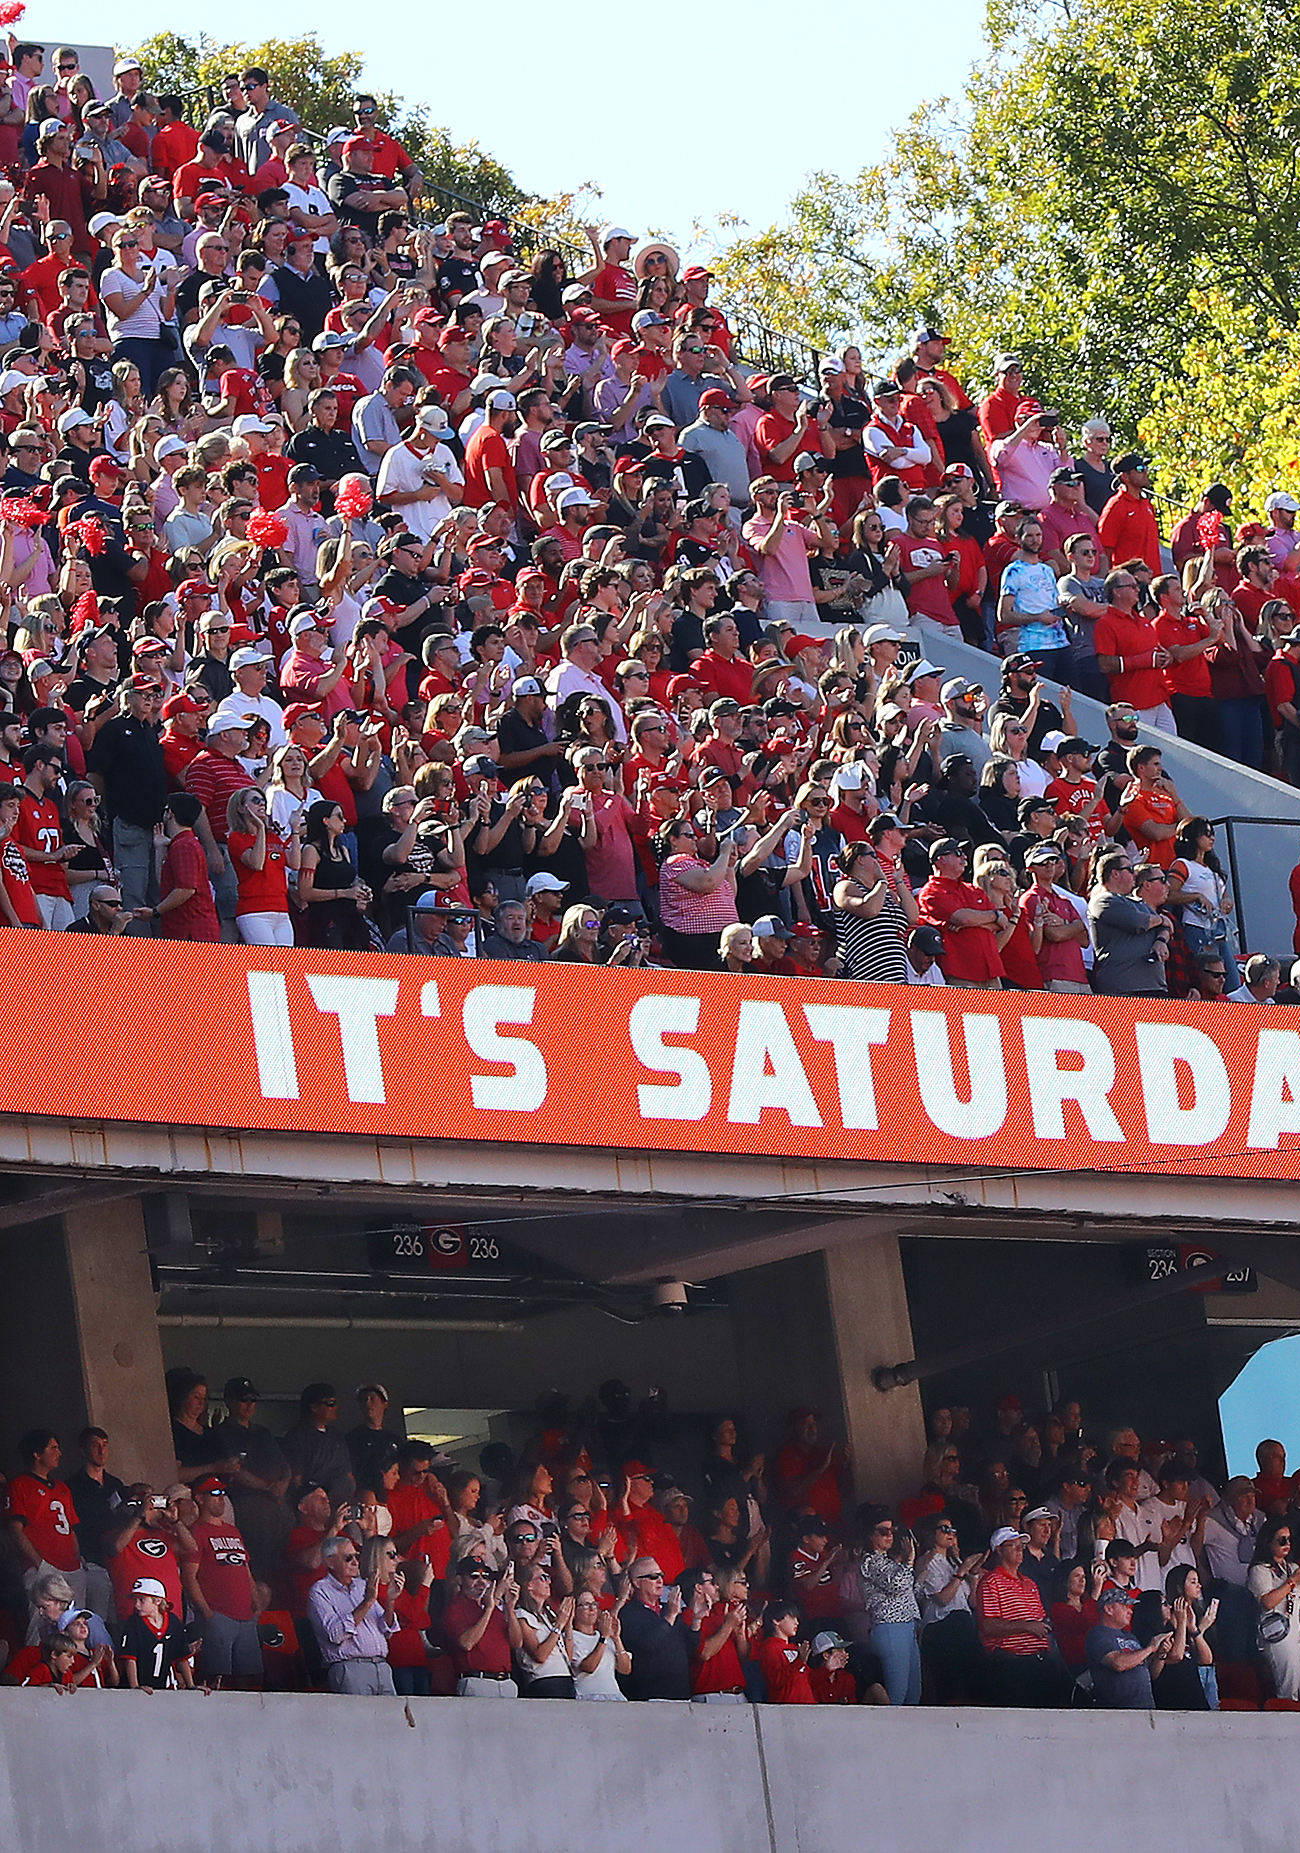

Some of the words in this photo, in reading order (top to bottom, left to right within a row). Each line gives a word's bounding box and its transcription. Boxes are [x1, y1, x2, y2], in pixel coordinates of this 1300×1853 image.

[247, 970, 548, 1112] IT'S
[393, 1235, 424, 1256] 236
[469, 1238, 499, 1259] 236
[1147, 1249, 1176, 1258] SECTION
[50, 1500, 70, 1535] 3
[152, 1642, 164, 1678] 1
